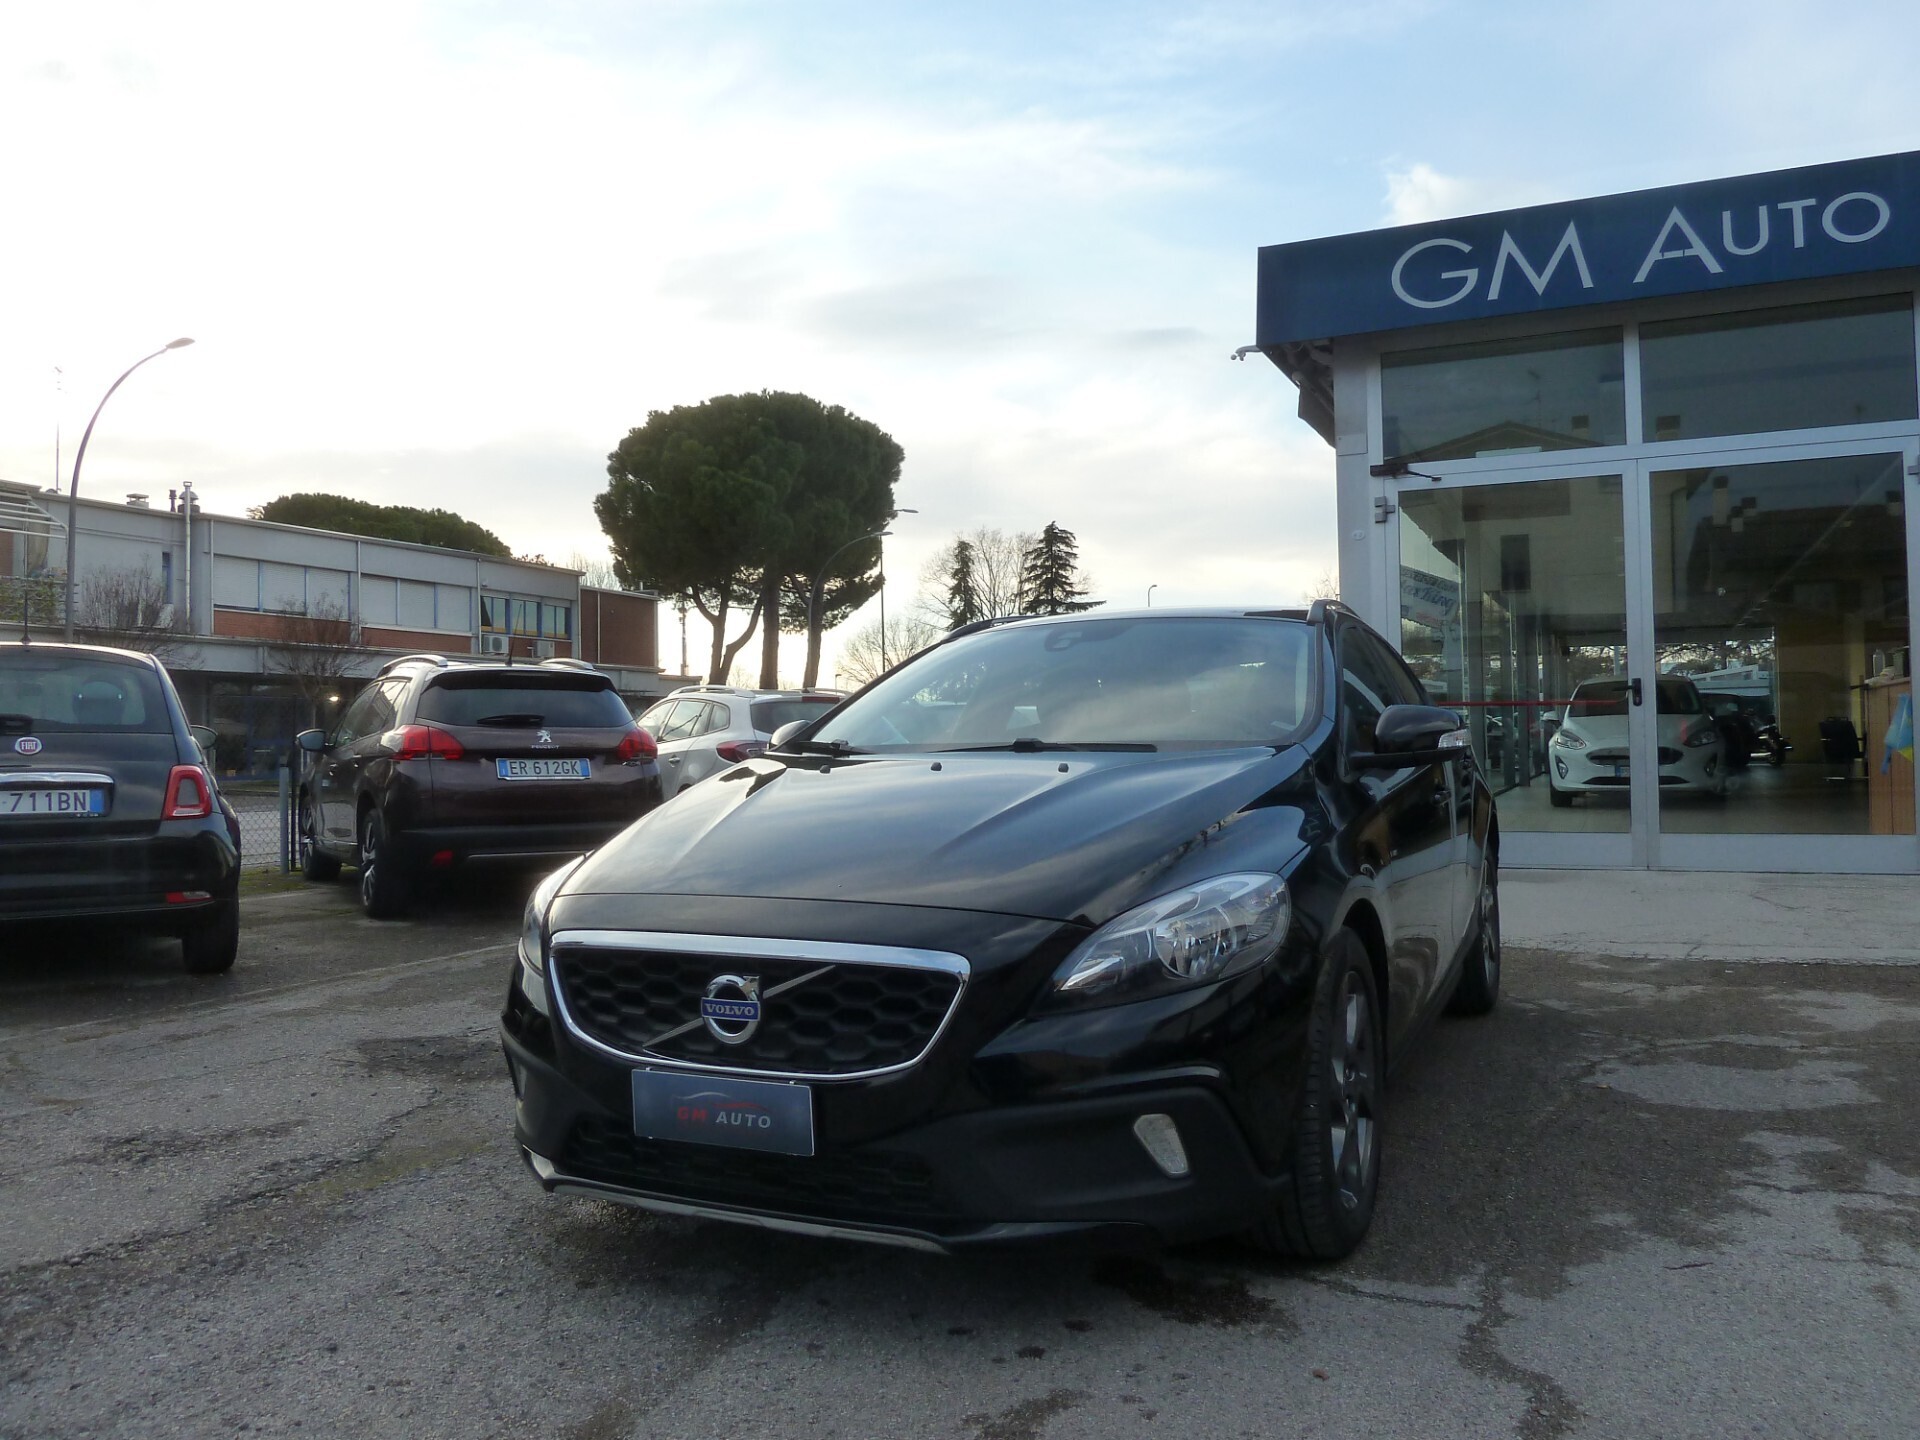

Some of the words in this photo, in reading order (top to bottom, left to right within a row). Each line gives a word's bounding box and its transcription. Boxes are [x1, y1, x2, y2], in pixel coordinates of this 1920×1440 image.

[1391, 219, 1594, 308] GM
[1633, 191, 1891, 284] AUTO
[20, 741, 37, 750] FIAT
[509, 761, 528, 775] ER
[533, 761, 580, 775] 612GK
[9, 792, 87, 812] 711BN
[704, 1003, 755, 1016] VOLVO
[677, 1106, 708, 1121] GM
[715, 1111, 771, 1129] AUTO
